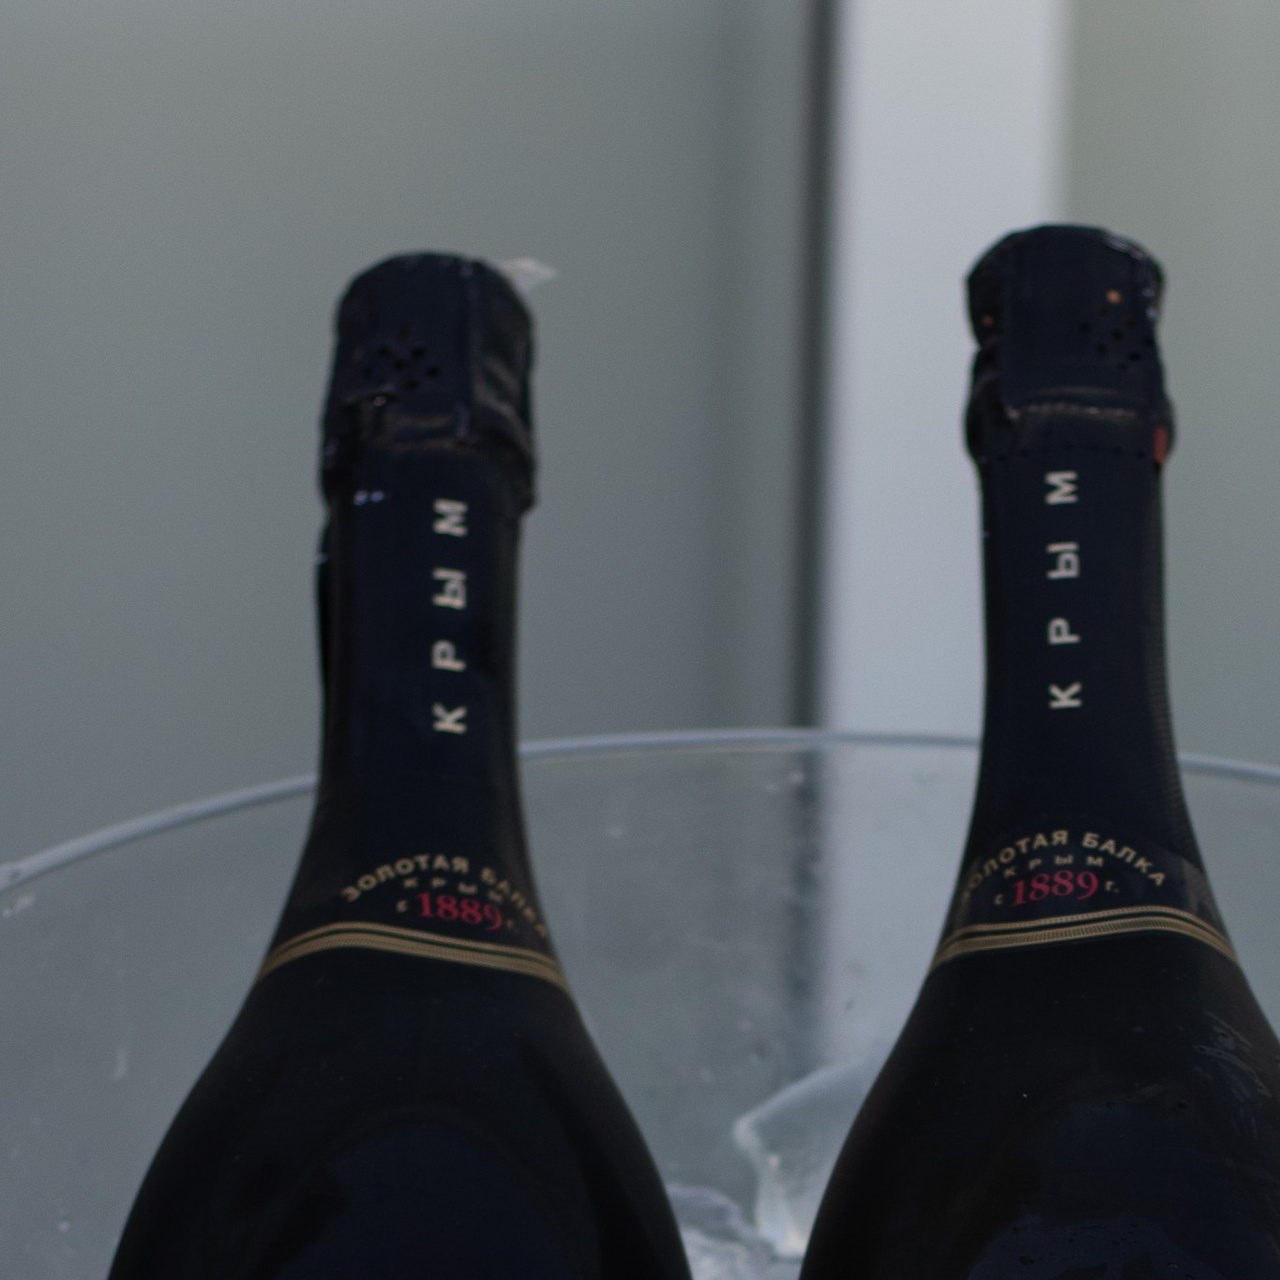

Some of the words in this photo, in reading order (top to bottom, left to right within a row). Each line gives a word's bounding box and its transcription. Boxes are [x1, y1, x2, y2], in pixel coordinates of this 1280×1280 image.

[431, 498, 469, 734] КРЫМ
[1047, 470, 1082, 709] КРЫМ
[1081, 831, 1167, 887] БАЛКА
[416, 891, 503, 932] 1889
[1010, 868, 1099, 908] 1889
